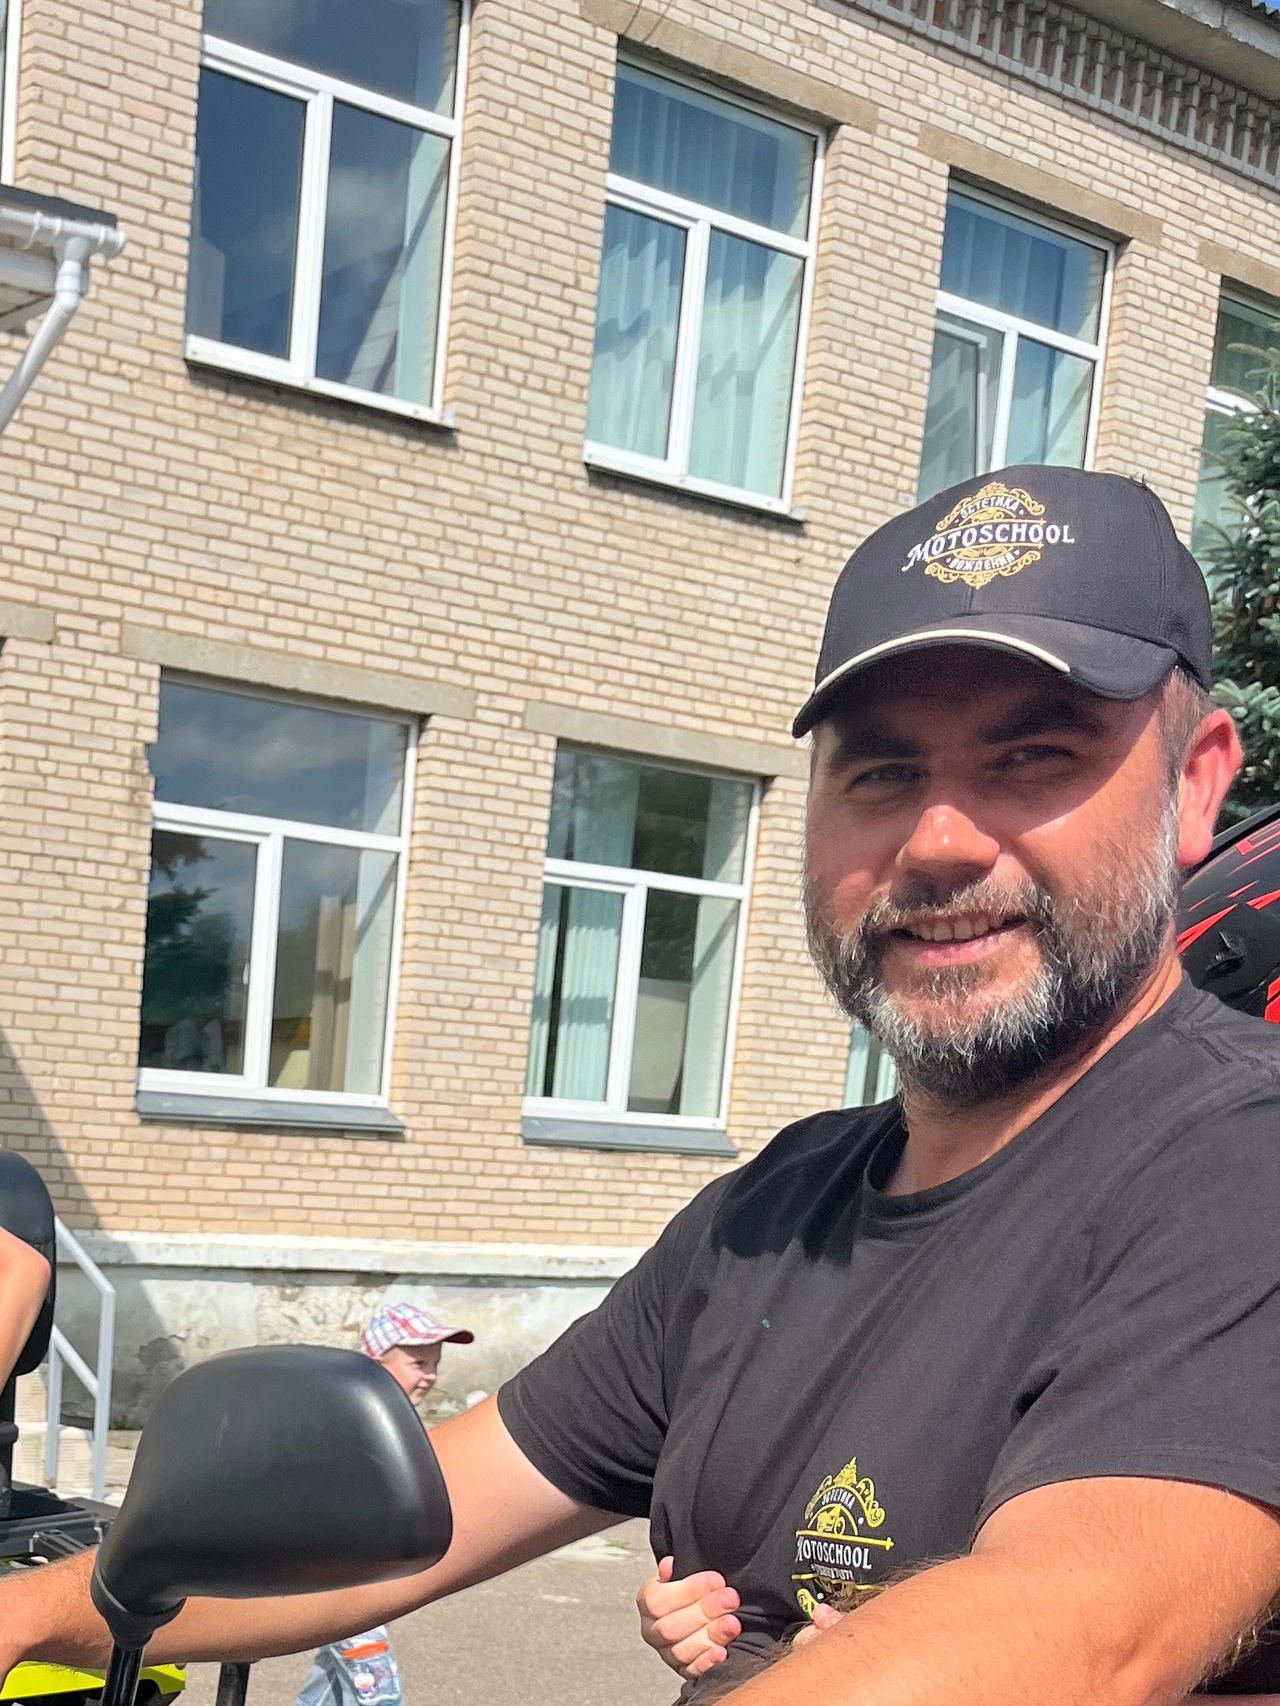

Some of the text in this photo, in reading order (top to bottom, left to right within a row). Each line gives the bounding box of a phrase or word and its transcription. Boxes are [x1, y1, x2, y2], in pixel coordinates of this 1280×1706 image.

[960, 495, 1019, 518] ЭСТЕТИКА
[901, 523, 1075, 572] MOTOSCHOOL
[949, 552, 1016, 572] ВОЖДЕНИЯ
